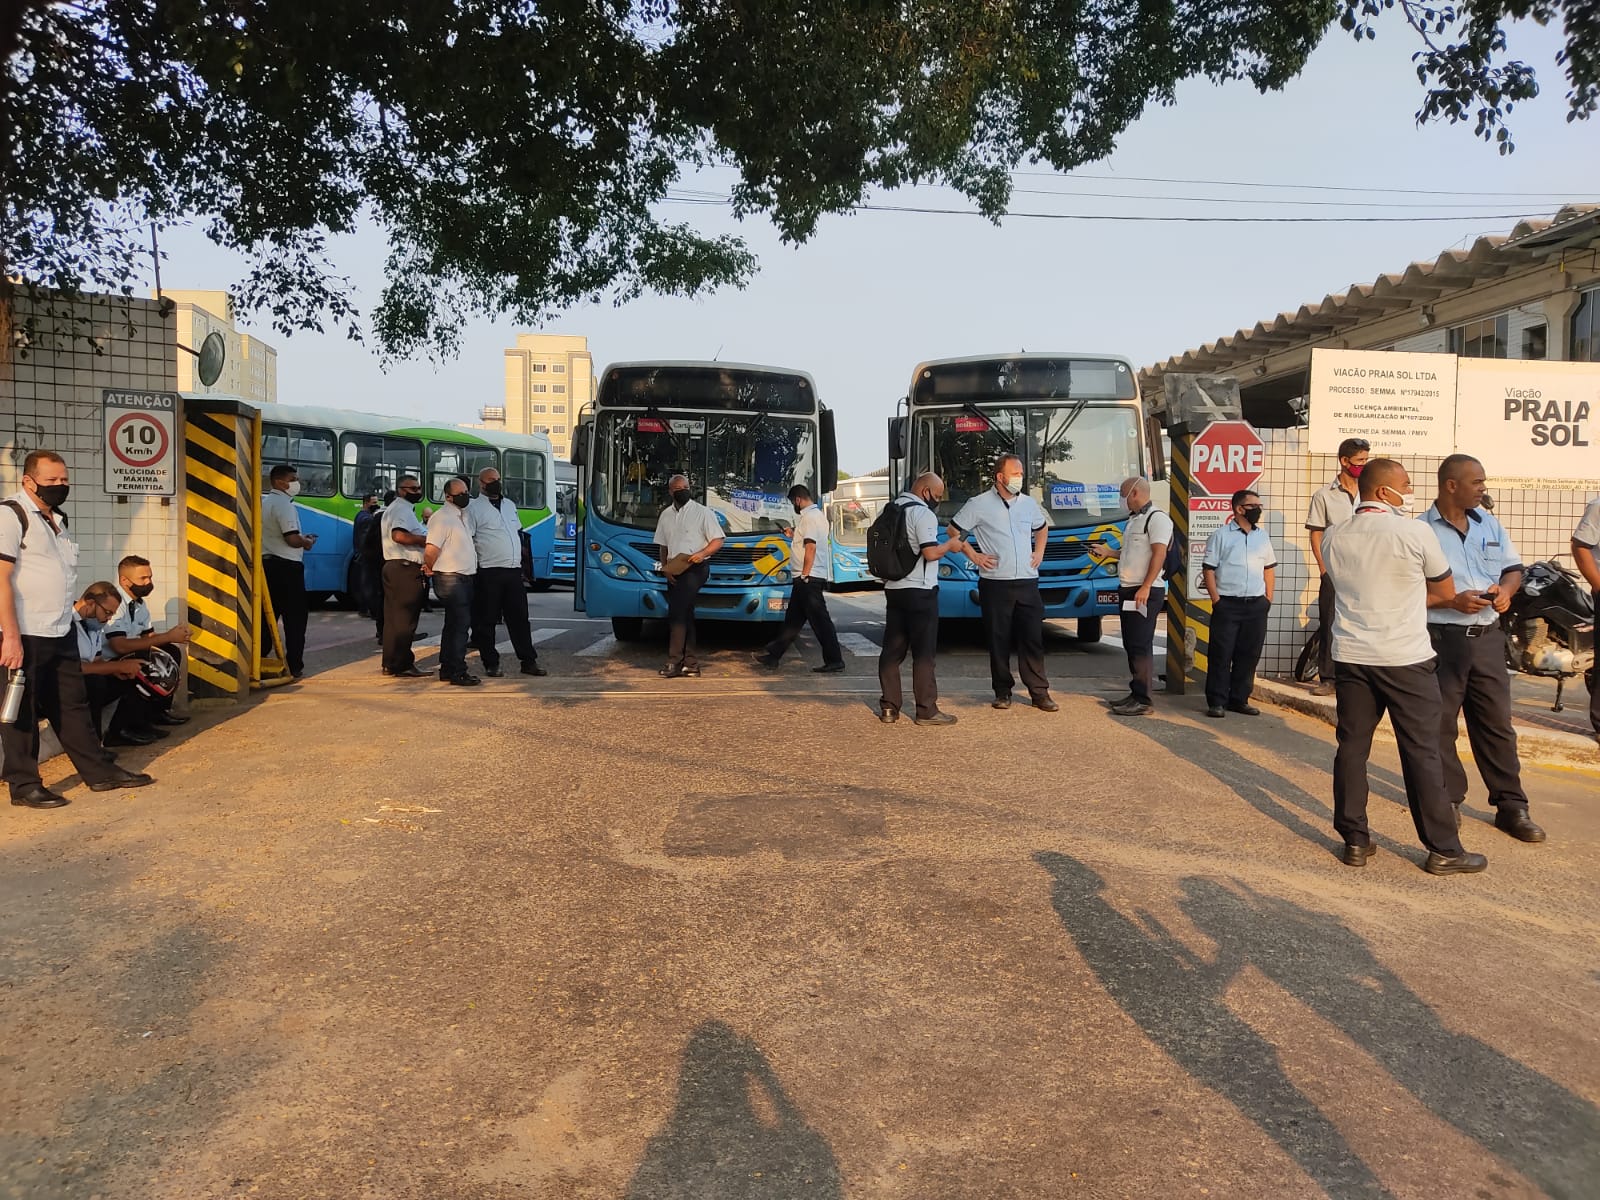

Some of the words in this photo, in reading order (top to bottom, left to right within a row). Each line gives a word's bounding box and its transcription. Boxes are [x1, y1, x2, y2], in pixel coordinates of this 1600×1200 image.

[1368, 369, 1395, 379] PRAIA
[1396, 370, 1413, 380] SOL
[1415, 371, 1437, 381] LTDA
[1504, 387, 1542, 399] Viação
[106, 393, 172, 409] ATENÇÃO
[1353, 404, 1382, 412] LICENÇA
[1383, 405, 1420, 413] AMBIENTAL
[1504, 398, 1590, 423] PRAIA
[122, 425, 156, 445] 10
[1338, 427, 1370, 435] TELEFONE
[1530, 423, 1589, 447] SOL
[125, 447, 153, 455] Km/h
[1193, 444, 1263, 473] PARE
[117, 483, 164, 491] PERMITIDA
[1198, 501, 1232, 510] AVIS
